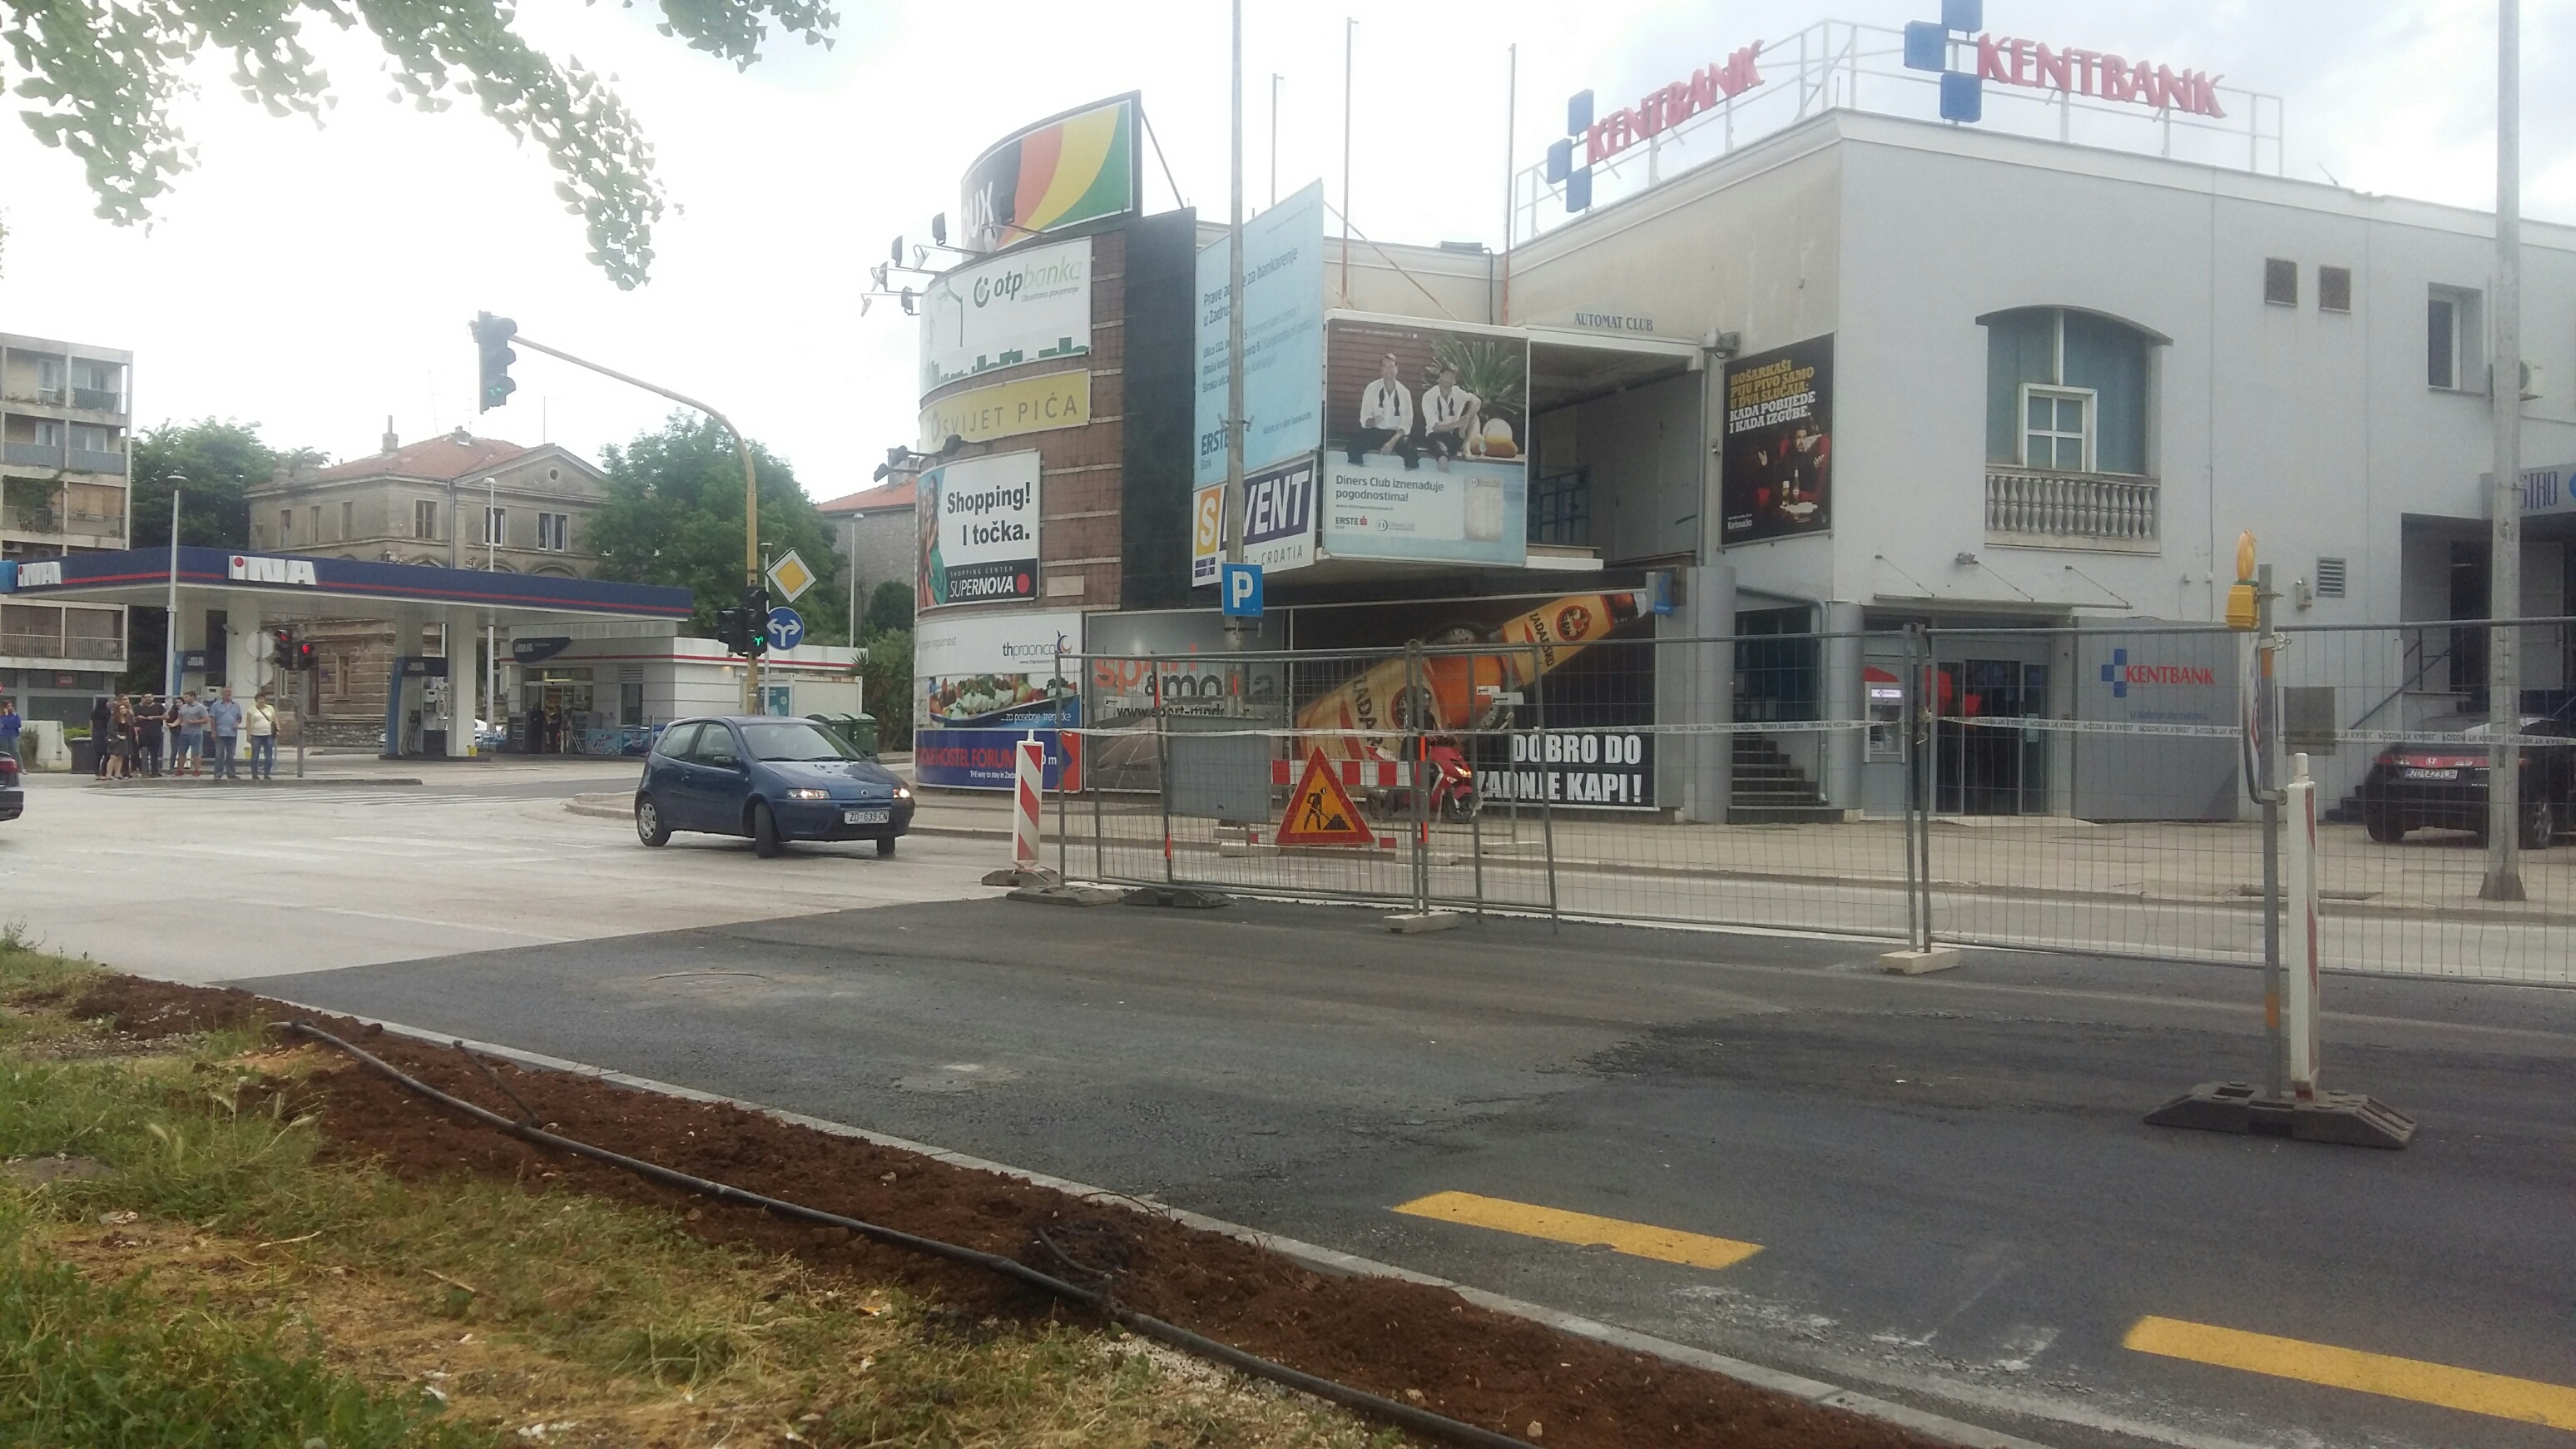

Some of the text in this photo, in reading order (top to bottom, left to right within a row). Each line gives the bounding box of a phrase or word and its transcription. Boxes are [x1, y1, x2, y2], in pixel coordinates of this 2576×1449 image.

[1977, 32, 2227, 119] KENTBANK
[1587, 39, 1766, 166] KENTBANK
[1204, 287, 1222, 307] Prave
[1248, 270, 1256, 284] za
[1257, 247, 1298, 279] bankarenje
[1575, 312, 1653, 331] AUTOMAT CLUB
[1731, 360, 1791, 385] KOŠARKAŠI
[1754, 375, 1781, 391] PIVO
[1730, 390, 1816, 422] KADA POBIJEDE
[1731, 399, 1737, 409] U
[1738, 393, 1760, 409] DVA
[944, 392, 1077, 439] SVIJET PIĆA
[1729, 405, 1811, 434] I KADA IZGUBE.
[1201, 428, 1229, 456] ERSTE
[1335, 474, 1444, 492] Diners Club iznenađuje
[1335, 489, 1409, 502] pogodnostima!
[947, 482, 1030, 515] Shopping!
[963, 520, 1030, 546] I točka.
[1335, 517, 1359, 525] ERSTE
[1262, 545, 1303, 566] CROATIA
[950, 565, 1013, 578] SHOPPING CENTER
[949, 575, 1014, 598] SUPERNOVA
[1232, 571, 1254, 608] P
[2126, 665, 2216, 685] KENTBANK
[938, 748, 969, 767] HOSTEL
[1513, 735, 1642, 765] DOBRO DO
[1567, 772, 1627, 802] KAPI
[850, 813, 859, 821] ZD
